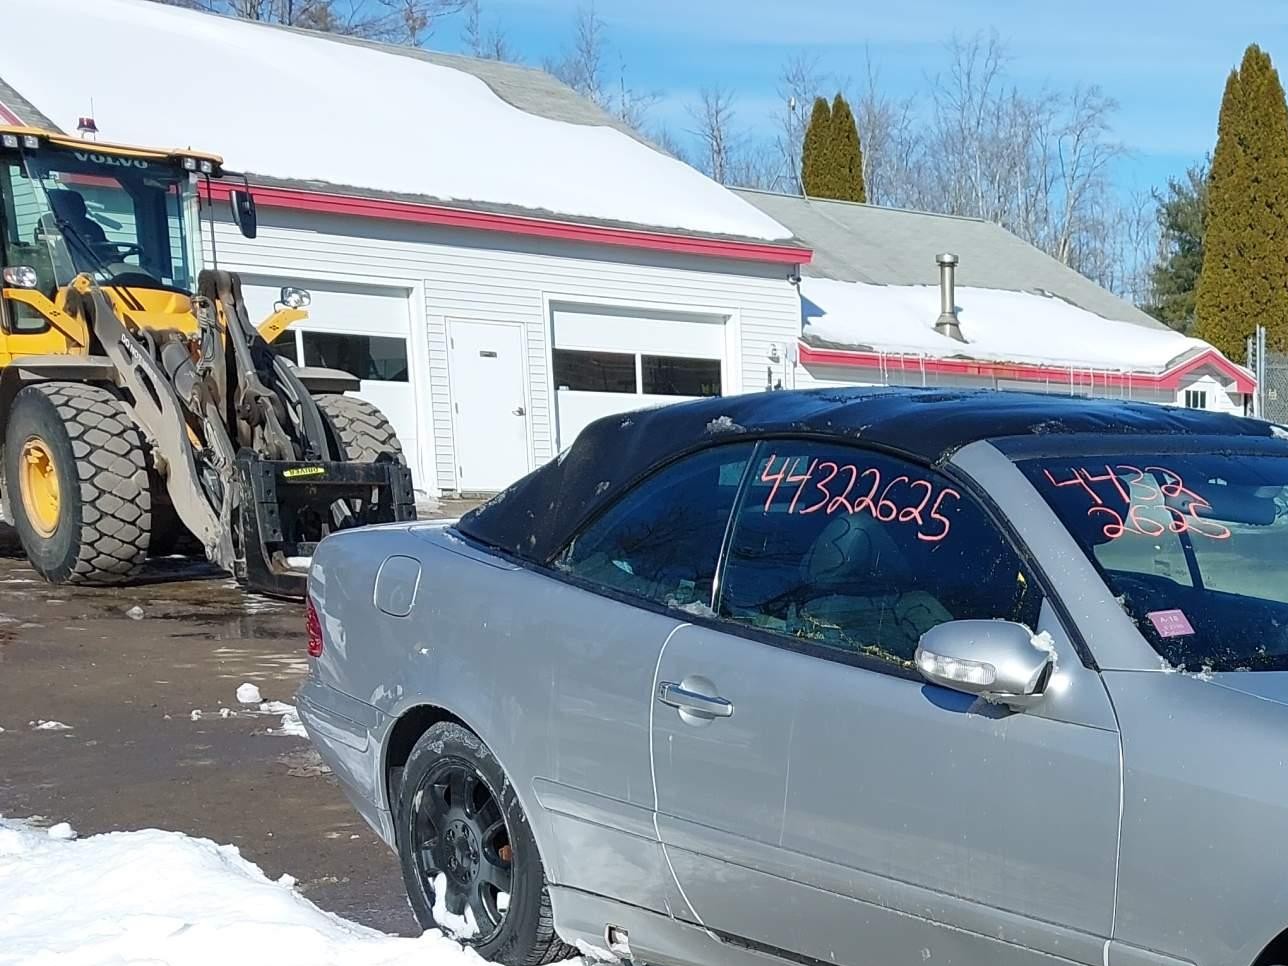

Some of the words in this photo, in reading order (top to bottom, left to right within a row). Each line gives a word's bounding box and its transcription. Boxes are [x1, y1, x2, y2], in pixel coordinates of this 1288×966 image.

[73, 151, 149, 169] VOLVO
[761, 453, 961, 541] 44322625
[1043, 464, 1212, 507] 4432
[1087, 503, 1231, 539] 2625
